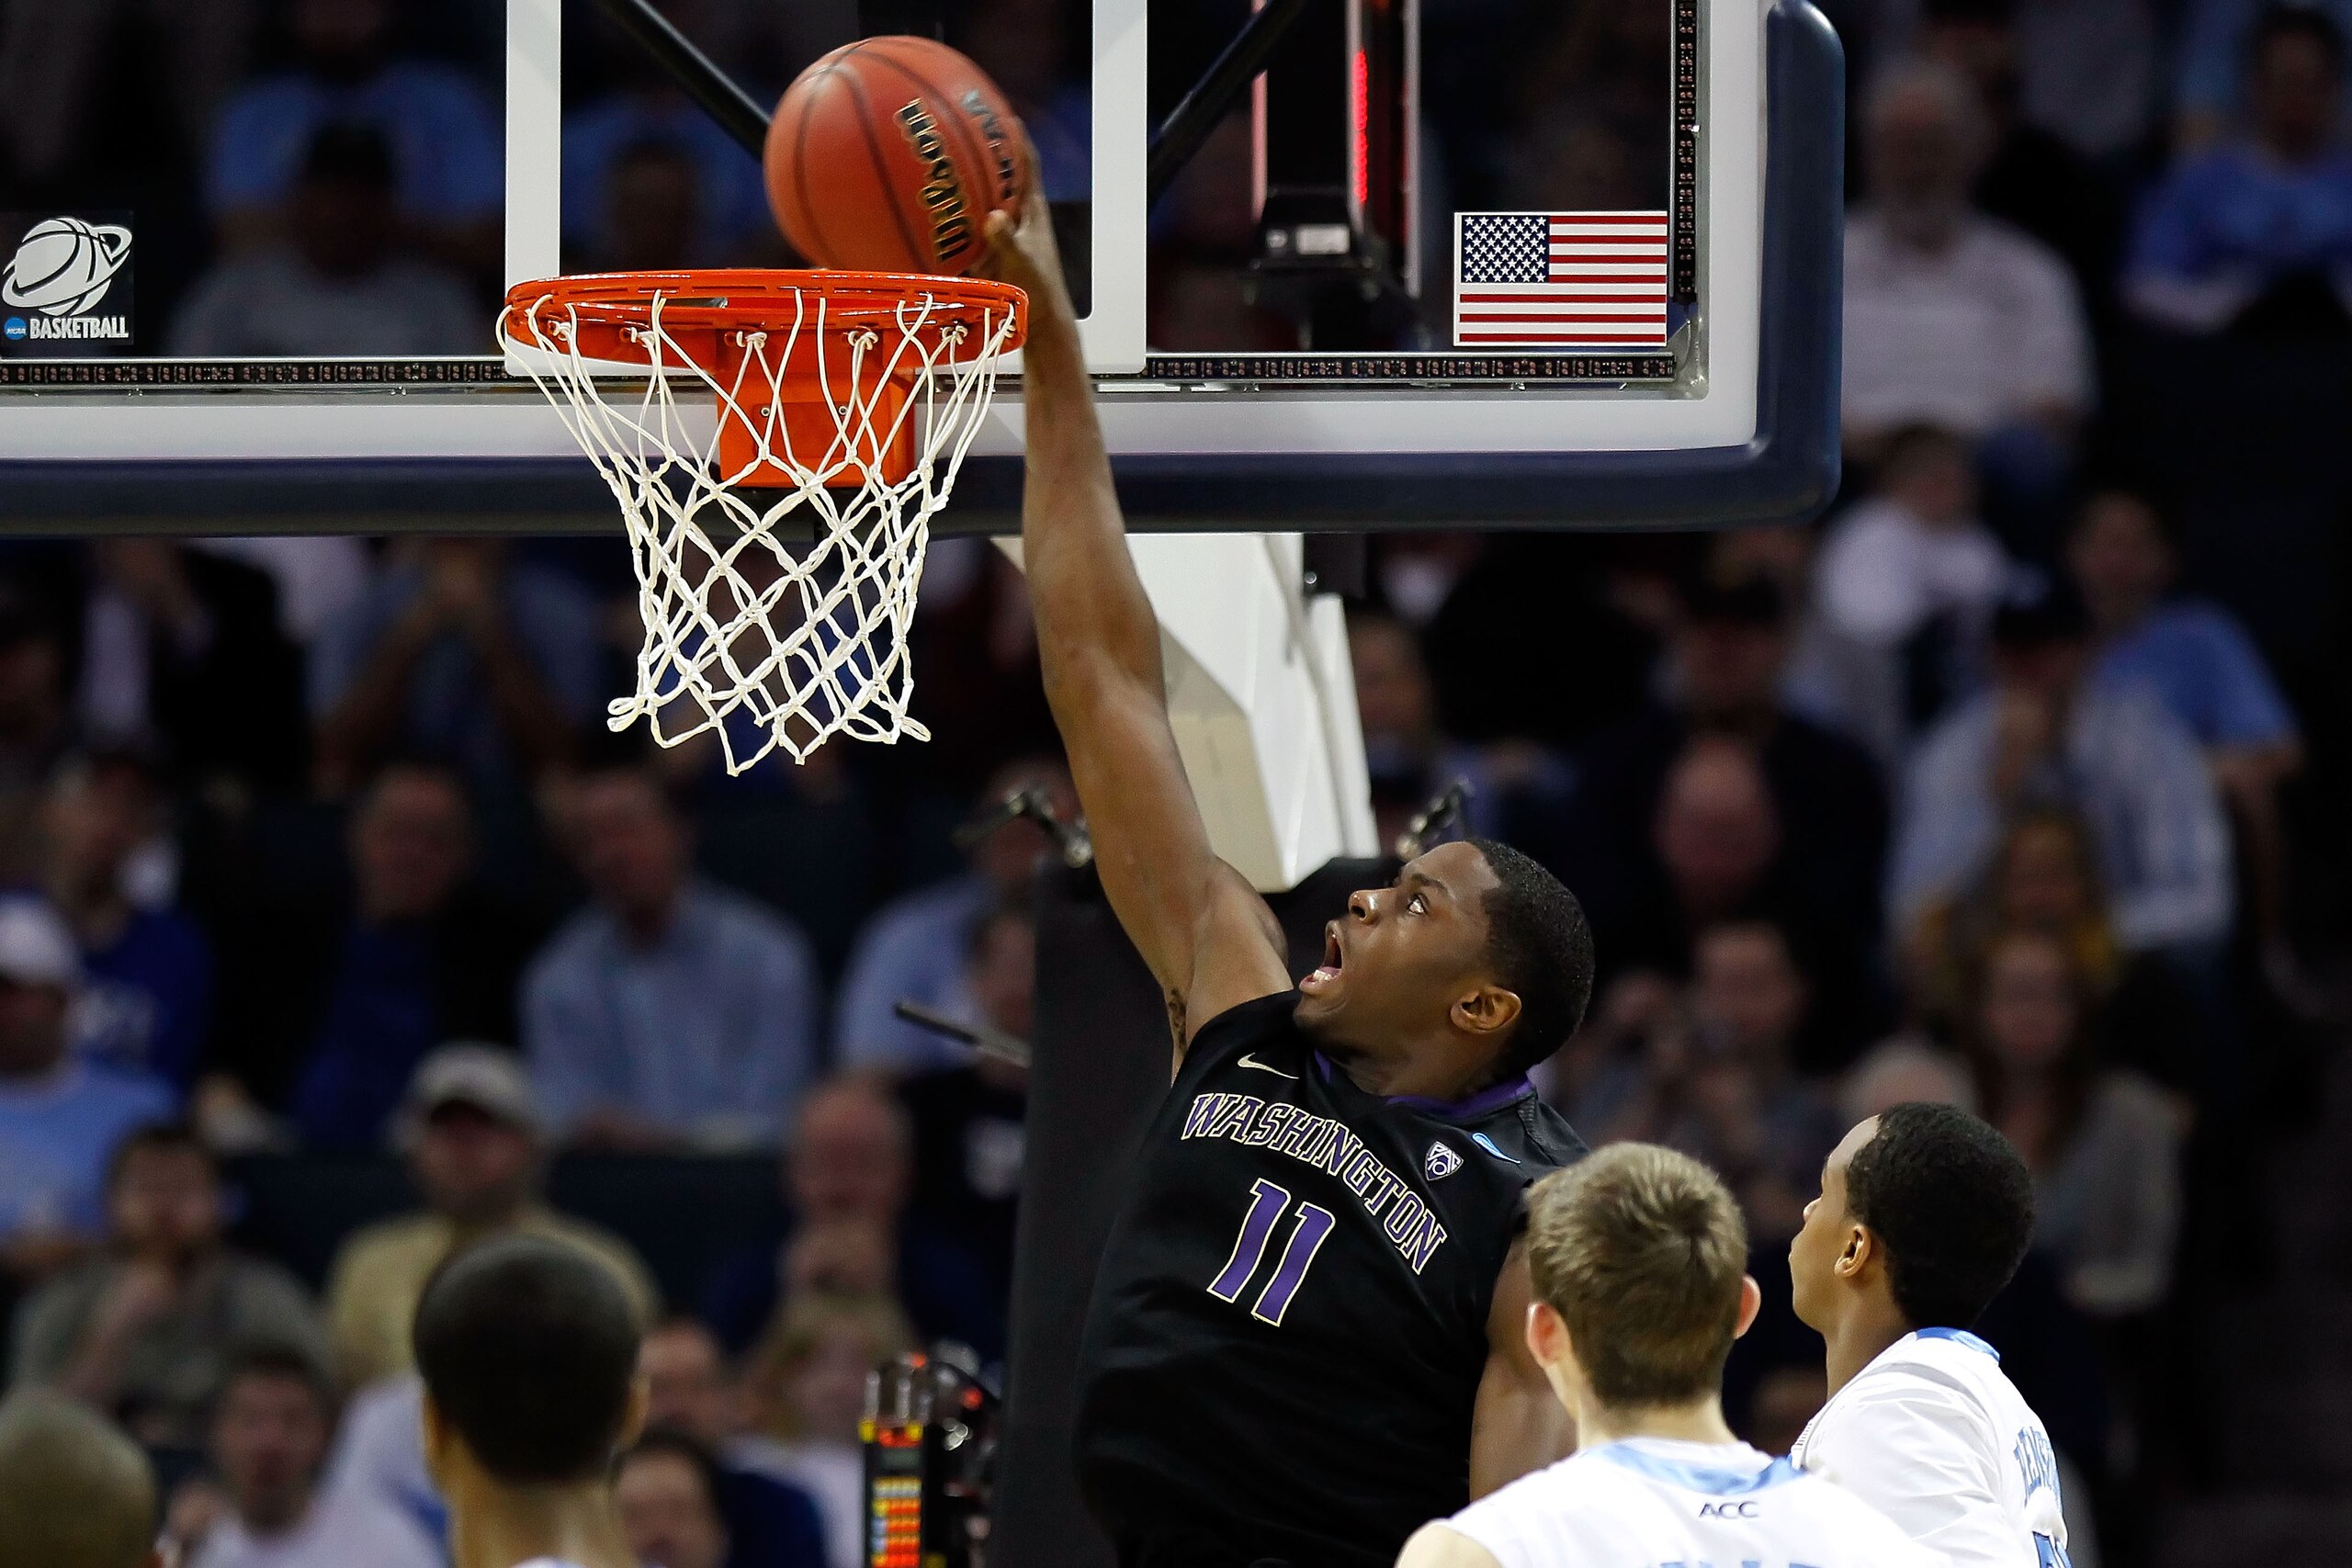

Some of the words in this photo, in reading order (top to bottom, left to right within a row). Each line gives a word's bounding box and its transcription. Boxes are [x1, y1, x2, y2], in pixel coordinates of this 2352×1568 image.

[29, 317, 129, 339] BASKETBALL
[1427, 1143, 1461, 1174] PAC
[1428, 1158, 1448, 1176] 10
[1182, 1094, 1447, 1274] WASHINGTON
[1207, 1178, 1335, 1326] 11
[1699, 1501, 1759, 1520] ACC
